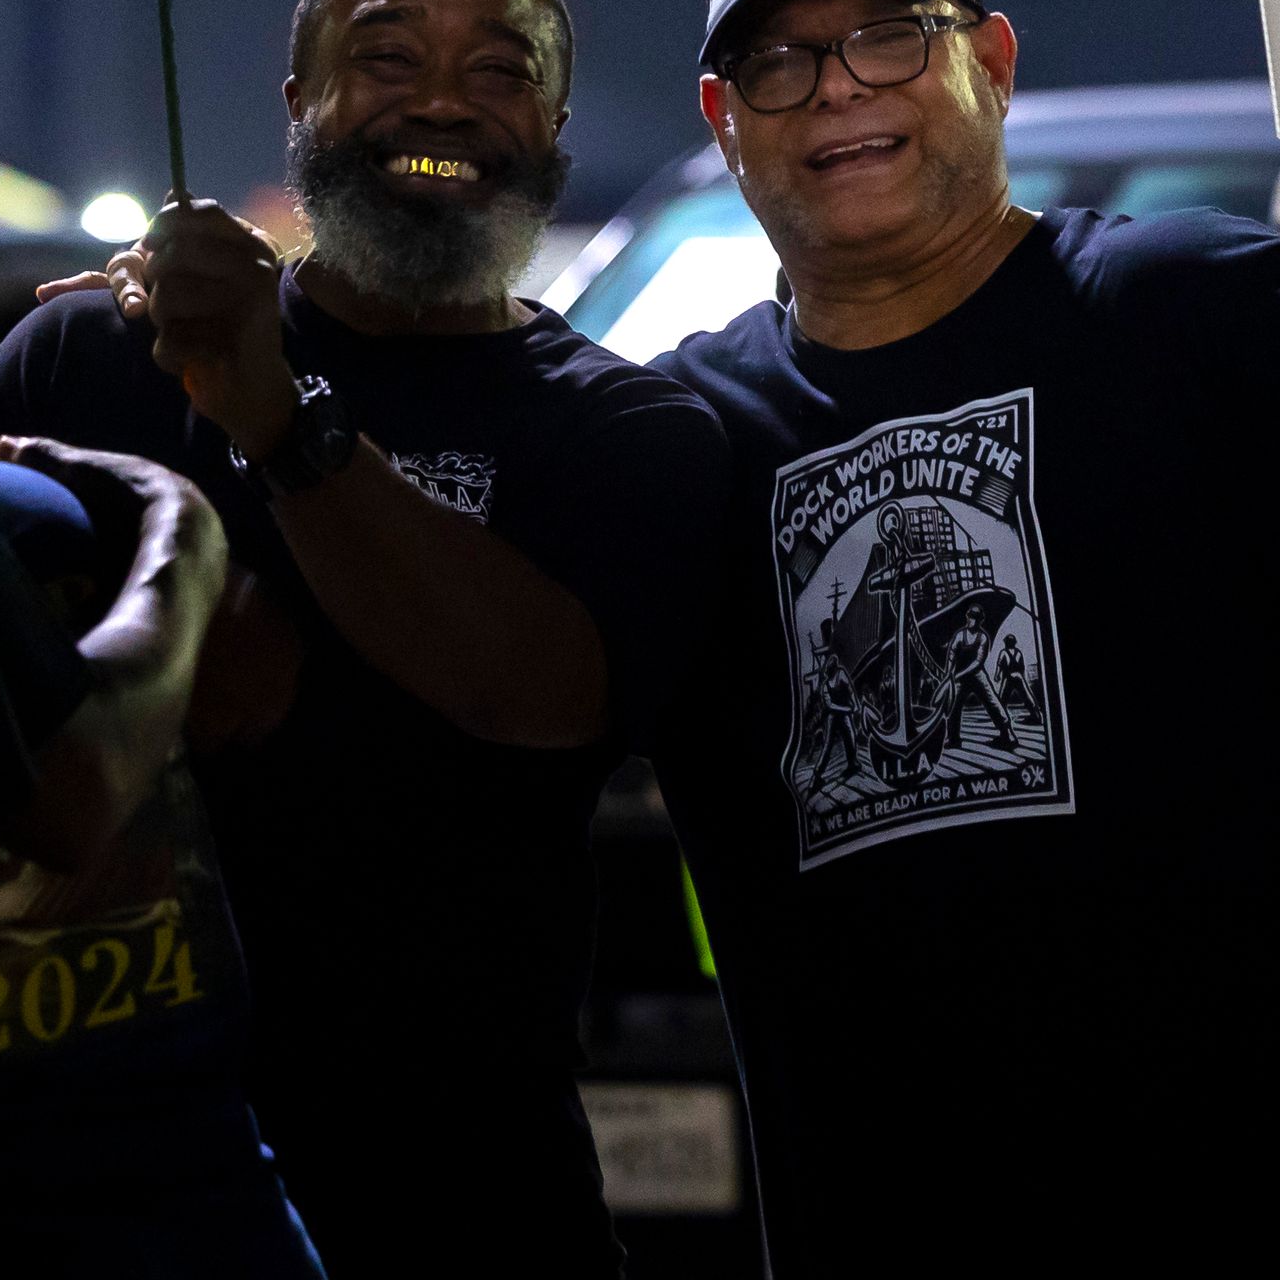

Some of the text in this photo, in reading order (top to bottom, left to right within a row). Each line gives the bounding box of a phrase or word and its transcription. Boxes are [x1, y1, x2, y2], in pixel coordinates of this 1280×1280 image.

[777, 429, 1022, 554] DOCK WORKERS OF THE
[809, 458, 980, 546] WORLD UNITE
[825, 814, 845, 831] WE
[847, 804, 871, 825] ARE
[874, 793, 918, 816] READY
[923, 786, 951, 803] FOR
[956, 784, 967, 798] A
[970, 776, 1009, 795] WAR
